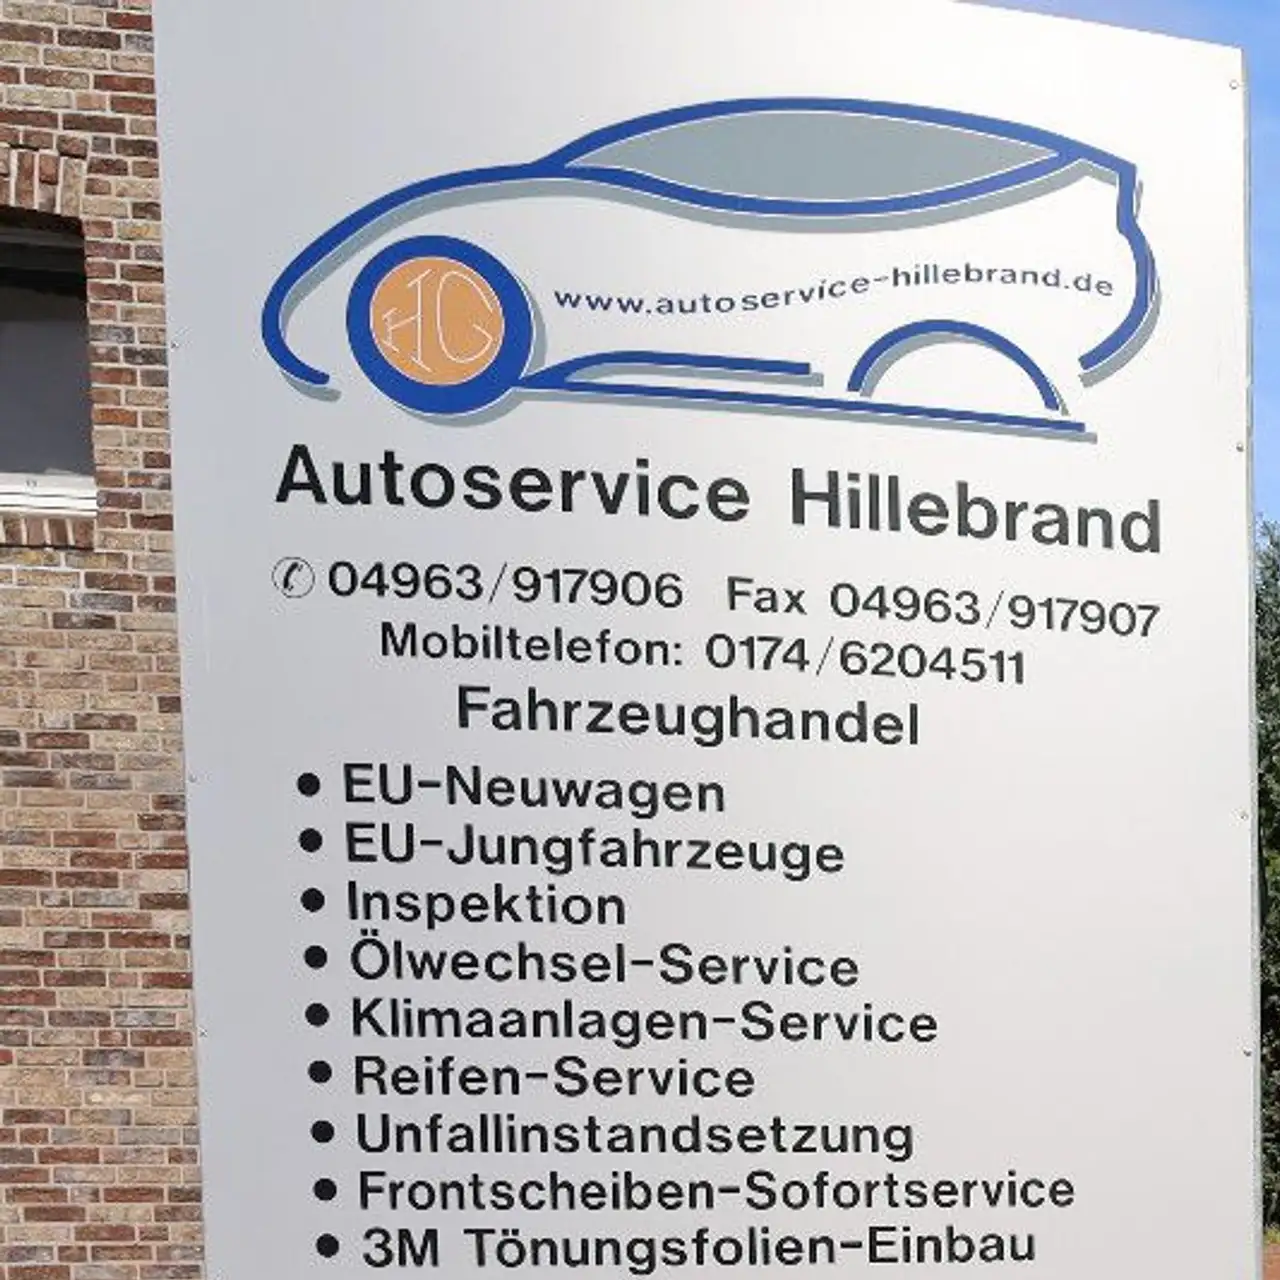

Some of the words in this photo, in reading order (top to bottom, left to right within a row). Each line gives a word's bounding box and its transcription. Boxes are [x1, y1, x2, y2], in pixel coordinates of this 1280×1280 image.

[554, 262, 1115, 315] www.autoservice-hillebrand.de
[275, 443, 750, 522] Autoservice
[792, 467, 1160, 553] Hillebrand
[328, 560, 683, 608] 04963/917906
[727, 576, 805, 614] Fax
[830, 583, 1160, 637] 04963/917907
[381, 621, 682, 666] Mobiltelefon:
[705, 633, 1023, 684] 0174/6204511
[458, 684, 918, 748] Fahrzeughandel
[343, 762, 724, 820] EU-Neuwagen
[345, 821, 844, 882] EU-Jungfahrzeuge
[347, 880, 625, 929] Inspektion
[350, 928, 859, 987] Ölwechsel-Service
[352, 997, 938, 1050] Klimaanlagen-Service
[354, 1055, 755, 1098] Reifen-Service
[357, 1113, 913, 1163] Unfallinstandsetzung
[359, 1169, 1074, 1211] Frontscheiben-Sofortservice
[362, 1226, 439, 1268] 3M
[463, 1225, 1035, 1276] Tönungsfolien-Einbau
